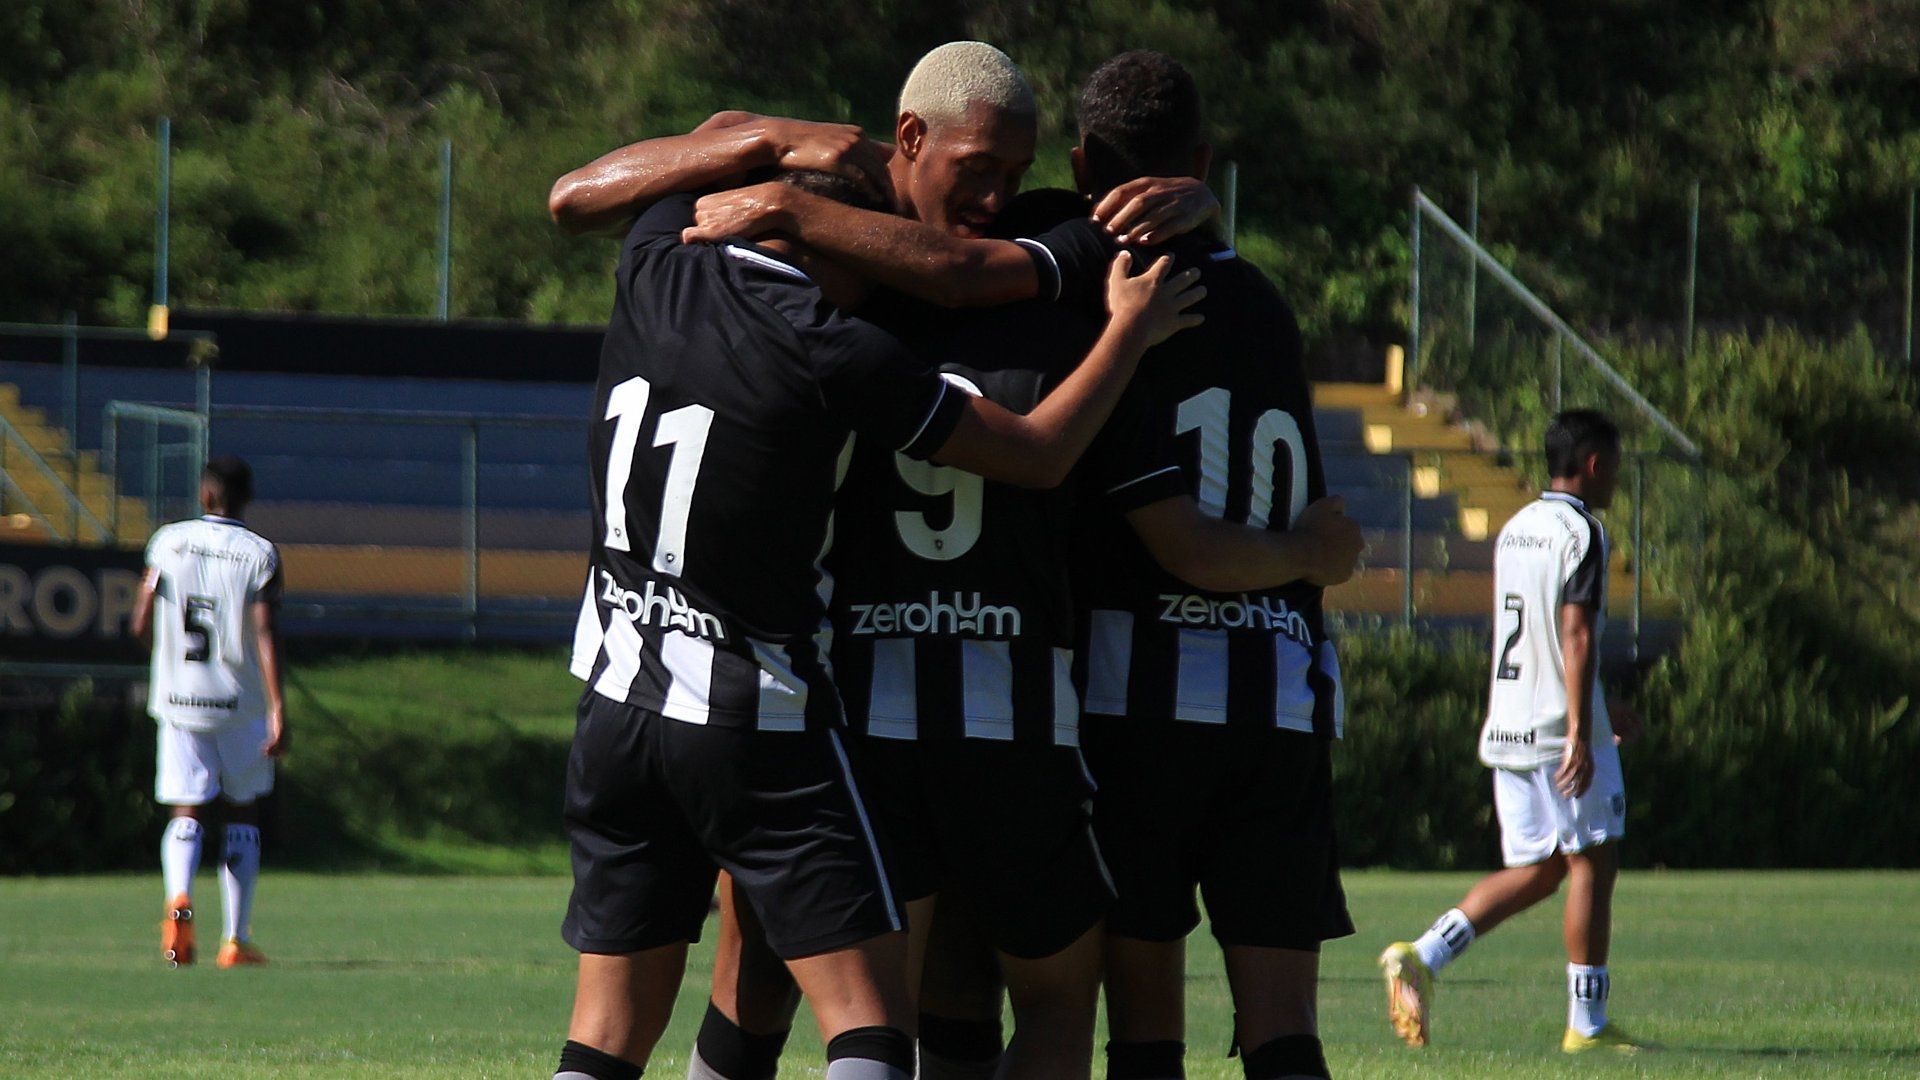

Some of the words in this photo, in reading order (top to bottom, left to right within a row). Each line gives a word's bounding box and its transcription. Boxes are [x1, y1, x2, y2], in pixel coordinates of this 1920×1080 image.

[604, 375, 715, 578] 11
[895, 371, 984, 561] 9
[1176, 387, 1308, 531] 10
[184, 596, 215, 663] 5
[602, 569, 725, 639] zohum
[850, 590, 1021, 635] zerohum
[1158, 592, 1313, 647] zerohum
[1497, 592, 1525, 680] 2
